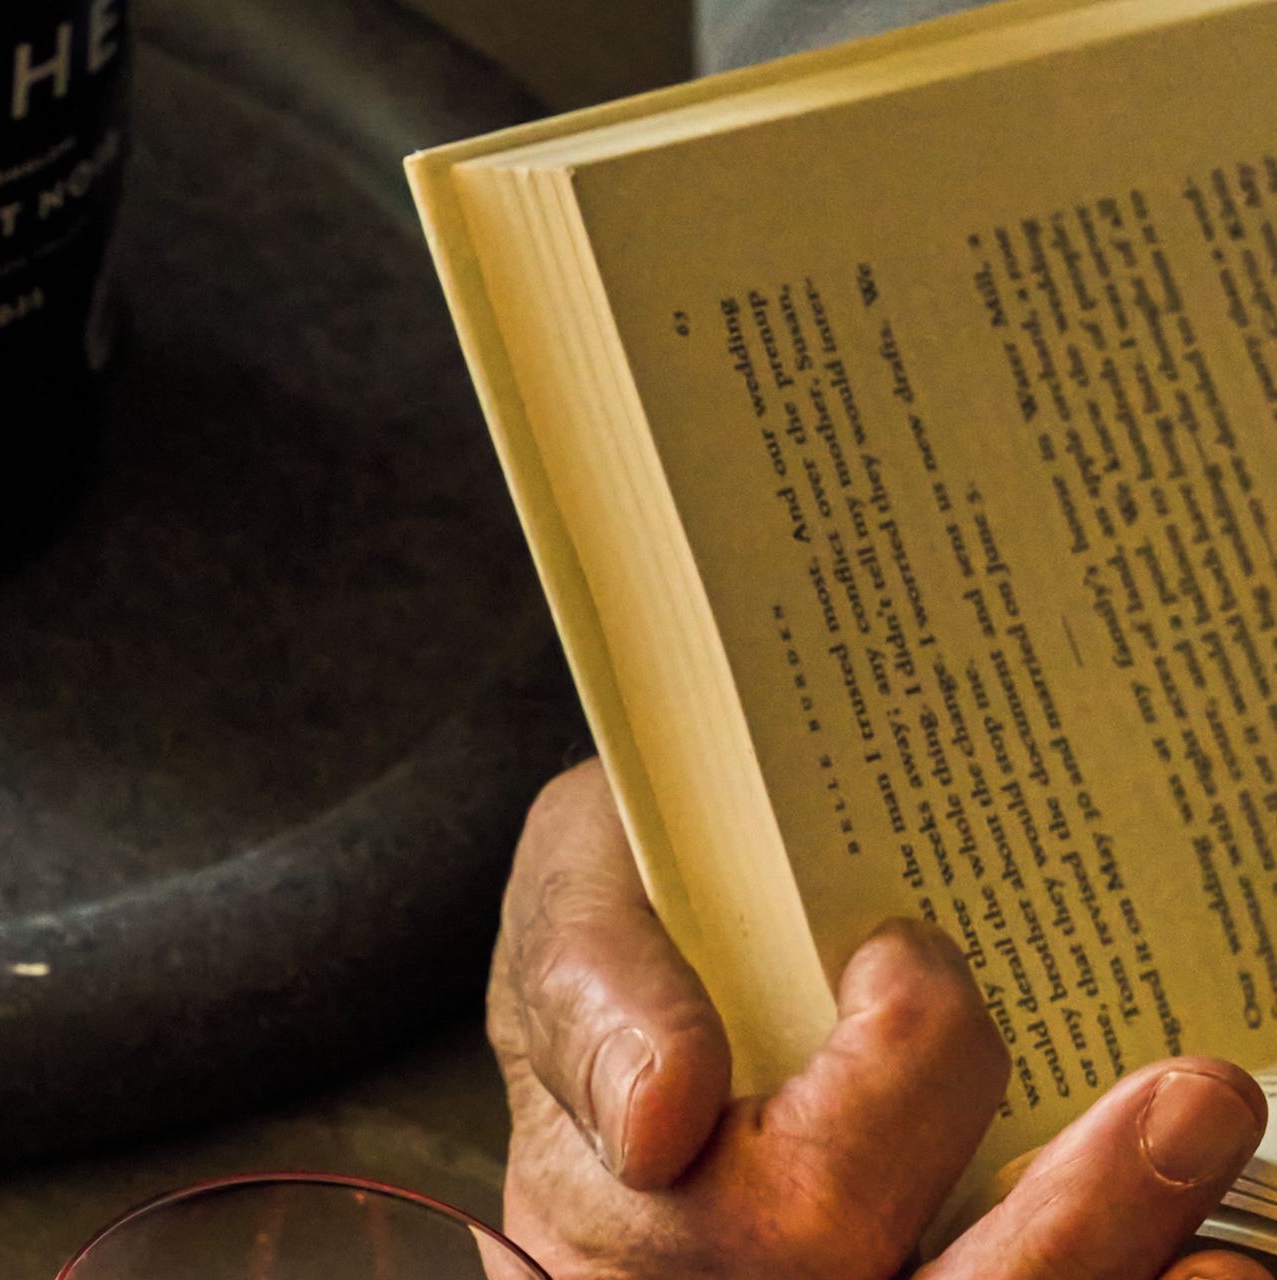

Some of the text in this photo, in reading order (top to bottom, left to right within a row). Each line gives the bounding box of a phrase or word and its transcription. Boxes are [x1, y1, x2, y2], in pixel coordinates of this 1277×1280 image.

[856, 263, 878, 307] We
[720, 297, 766, 417] wedding
[747, 290, 794, 389] prenup
[784, 402, 806, 444] the
[823, 359, 866, 445] would
[761, 428, 786, 477] our
[908, 413, 937, 471] new
[803, 458, 831, 518] over
[860, 454, 891, 513] they
[932, 482, 952, 512] us
[776, 486, 811, 543] And
[845, 496, 868, 539] my
[973, 513, 1010, 575] June
[856, 544, 885, 590] tell
[878, 518, 928, 629] worried
[946, 523, 974, 578] sent
[827, 530, 870, 634] conflict
[997, 574, 1019, 617] on
[962, 588, 995, 637] and
[828, 642, 874, 740] trusted
[865, 648, 890, 695] any
[1006, 623, 1061, 729] married
[983, 715, 1013, 775] stop
[989, 649, 1050, 787] document
[968, 763, 993, 807] the
[1049, 735, 1083, 785] and
[877, 772, 906, 833] man
[1000, 779, 1048, 868] would
[1046, 796, 1071, 841] the
[917, 800, 954, 887] weeks
[945, 793, 984, 879] whole
[986, 812, 1025, 891] about
[1092, 832, 1124, 892] May
[900, 844, 924, 888] the
[981, 884, 1006, 930] the
[1042, 877, 1075, 936] they
[1060, 850, 1114, 946] revised
[1119, 897, 1141, 934] on
[952, 897, 986, 969] three
[1018, 898, 1067, 1003] brother
[1134, 940, 1152, 963] it
[993, 936, 1038, 1013] derail
[1069, 943, 1098, 997] that
[1109, 955, 1141, 1026] Tom
[983, 982, 1016, 1044] only
[1060, 1007, 1087, 1051] my
[1014, 1055, 1040, 1109] was
[1026, 1018, 1070, 1098] could
[1079, 1057, 1107, 1089] or
